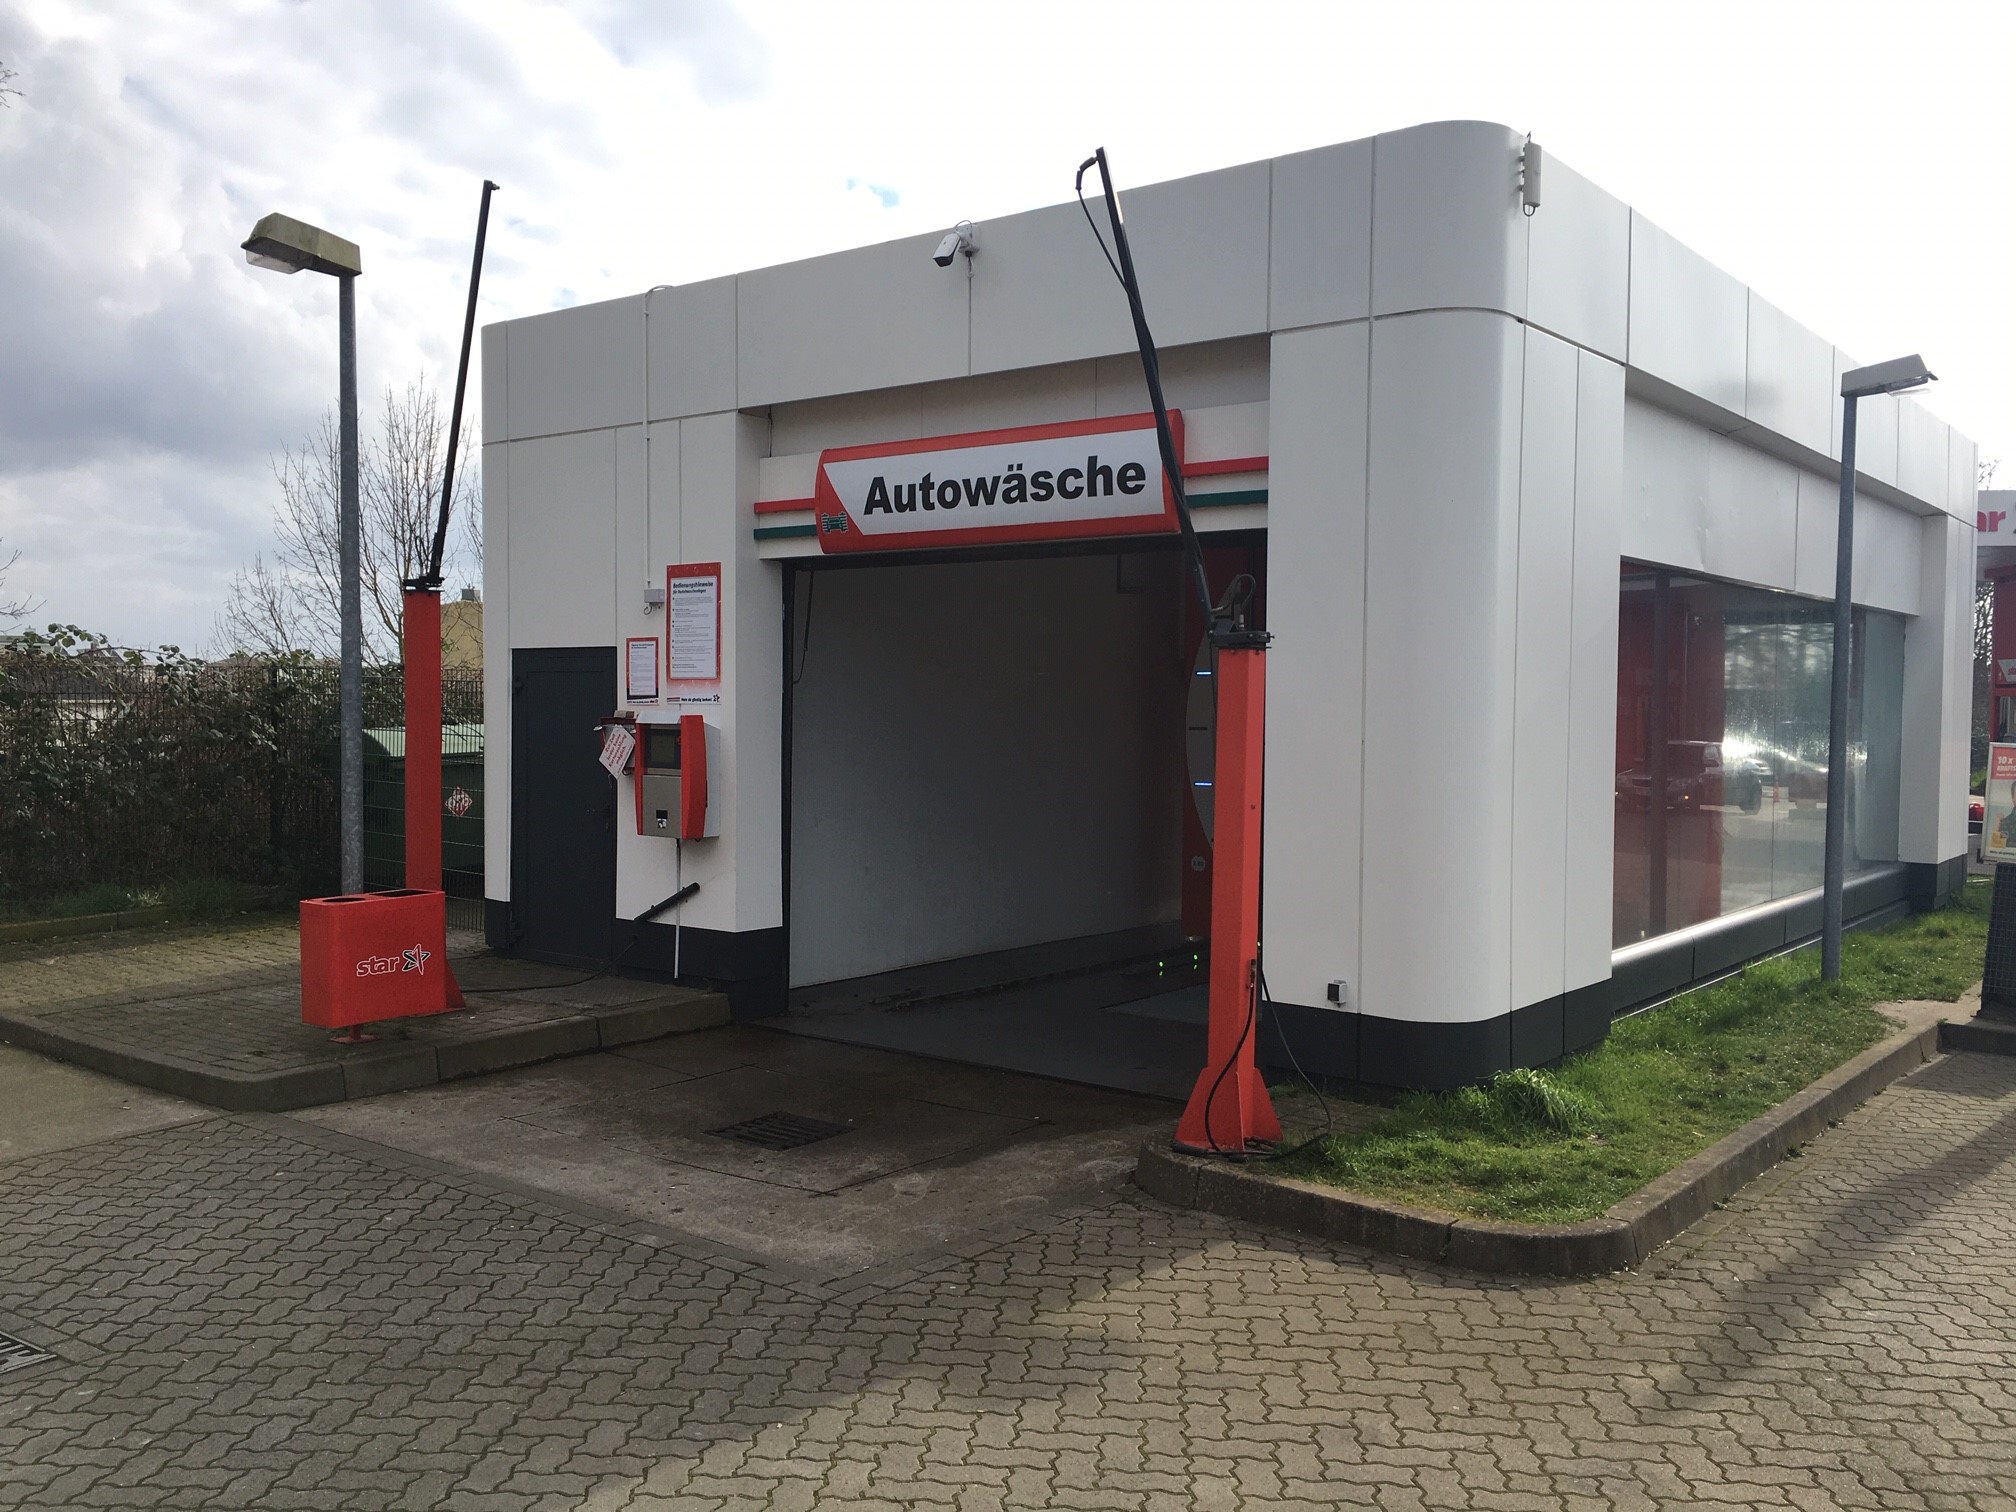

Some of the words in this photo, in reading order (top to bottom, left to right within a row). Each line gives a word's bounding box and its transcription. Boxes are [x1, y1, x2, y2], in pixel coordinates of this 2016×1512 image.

[863, 455, 1146, 516] Autowäsche
[1997, 756, 2007, 765] 10
[357, 956, 399, 976] star
